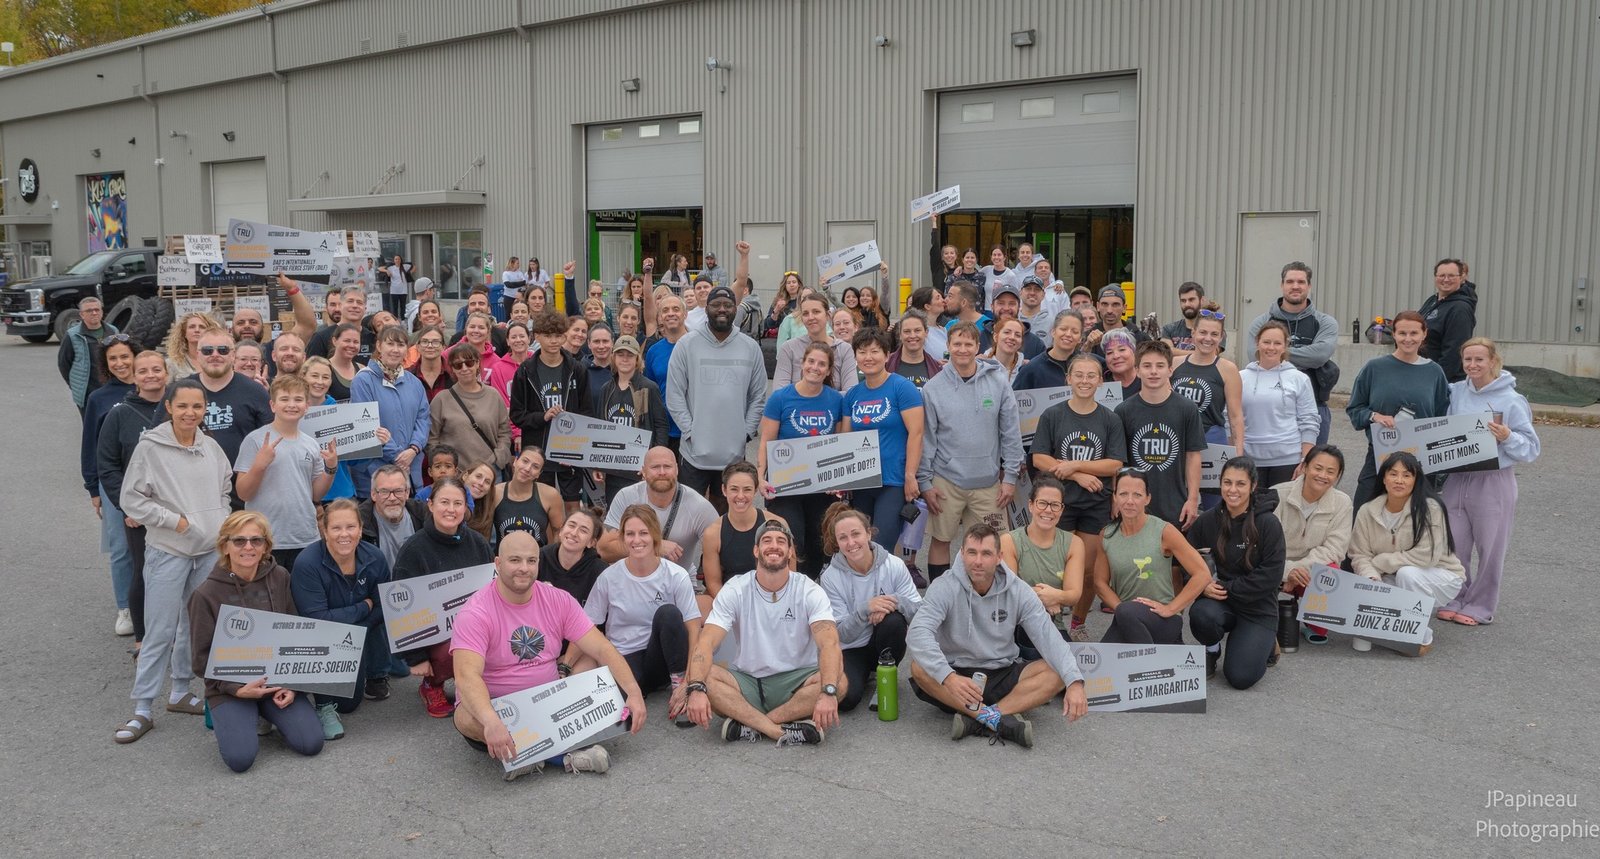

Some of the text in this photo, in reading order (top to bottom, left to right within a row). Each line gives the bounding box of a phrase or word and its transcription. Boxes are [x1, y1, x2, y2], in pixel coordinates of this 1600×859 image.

[236, 228, 251, 237] TRU
[1177, 386, 1202, 403] TRU
[856, 404, 882, 415] NCR
[560, 419, 572, 428] TRU
[800, 416, 827, 426] NCR
[355, 430, 375, 442] TURBOS
[1382, 431, 1396, 440] TRU
[776, 448, 790, 457] TRU
[1070, 445, 1094, 461] TRU
[1142, 439, 1169, 455] TRU
[590, 454, 613, 463] CHICKEN
[614, 456, 639, 464] NUGGETS
[1428, 443, 1480, 465] FUN FIT MOMS
[817, 471, 832, 483] WOD
[834, 467, 844, 479] DID
[846, 465, 856, 475] WE
[857, 458, 876, 471] DO?!?
[428, 580, 448, 590] OCTOBER
[453, 571, 464, 581] 2025
[1320, 575, 1335, 586] TRU
[1354, 583, 1373, 591] OCTOBER
[391, 591, 408, 603] TRU
[230, 618, 249, 630] TRU
[1353, 614, 1379, 630] BUNZ
[1382, 619, 1390, 631] &
[1392, 620, 1421, 634] GUNZ
[1118, 649, 1137, 659] OCTOBER
[1144, 647, 1156, 655] 2025
[1080, 655, 1096, 664] TRU
[274, 660, 358, 675] LES BELLES-SOEURS
[531, 690, 551, 703] OCTOBER
[556, 681, 567, 692] 2025
[1129, 678, 1199, 700] LES MARGARITAS
[558, 699, 617, 741] ABS & ATTITUDE
